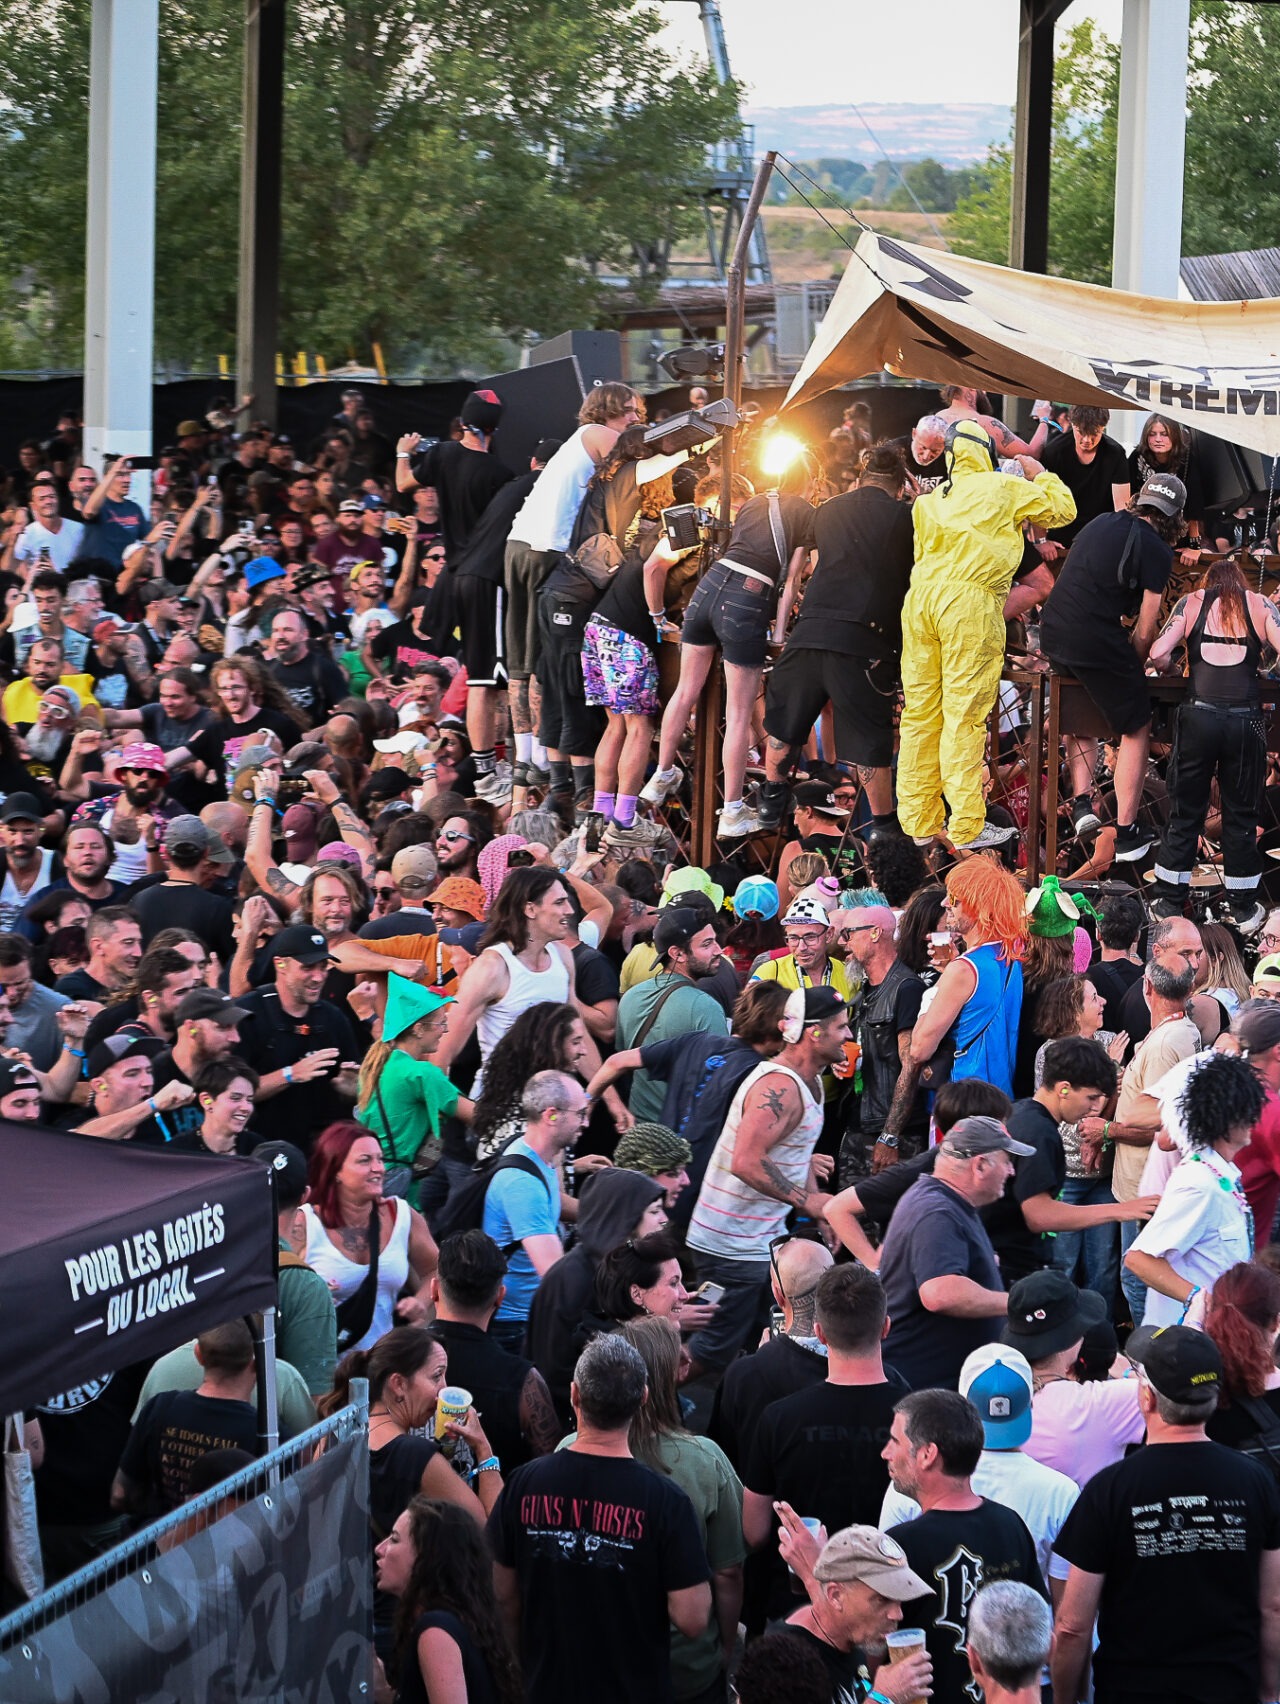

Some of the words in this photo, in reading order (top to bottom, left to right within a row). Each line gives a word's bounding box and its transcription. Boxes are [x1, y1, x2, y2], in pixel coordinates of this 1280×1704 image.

[1147, 483, 1176, 499] adidas
[64, 1243, 124, 1302] POUR
[122, 1229, 162, 1280] LES
[163, 1201, 225, 1265] AGITÉS
[106, 1288, 134, 1336] DU
[135, 1265, 197, 1323] LOCAL
[520, 1495, 563, 1527] GUNS
[571, 1498, 589, 1529] N'
[592, 1500, 645, 1540] ROSES
